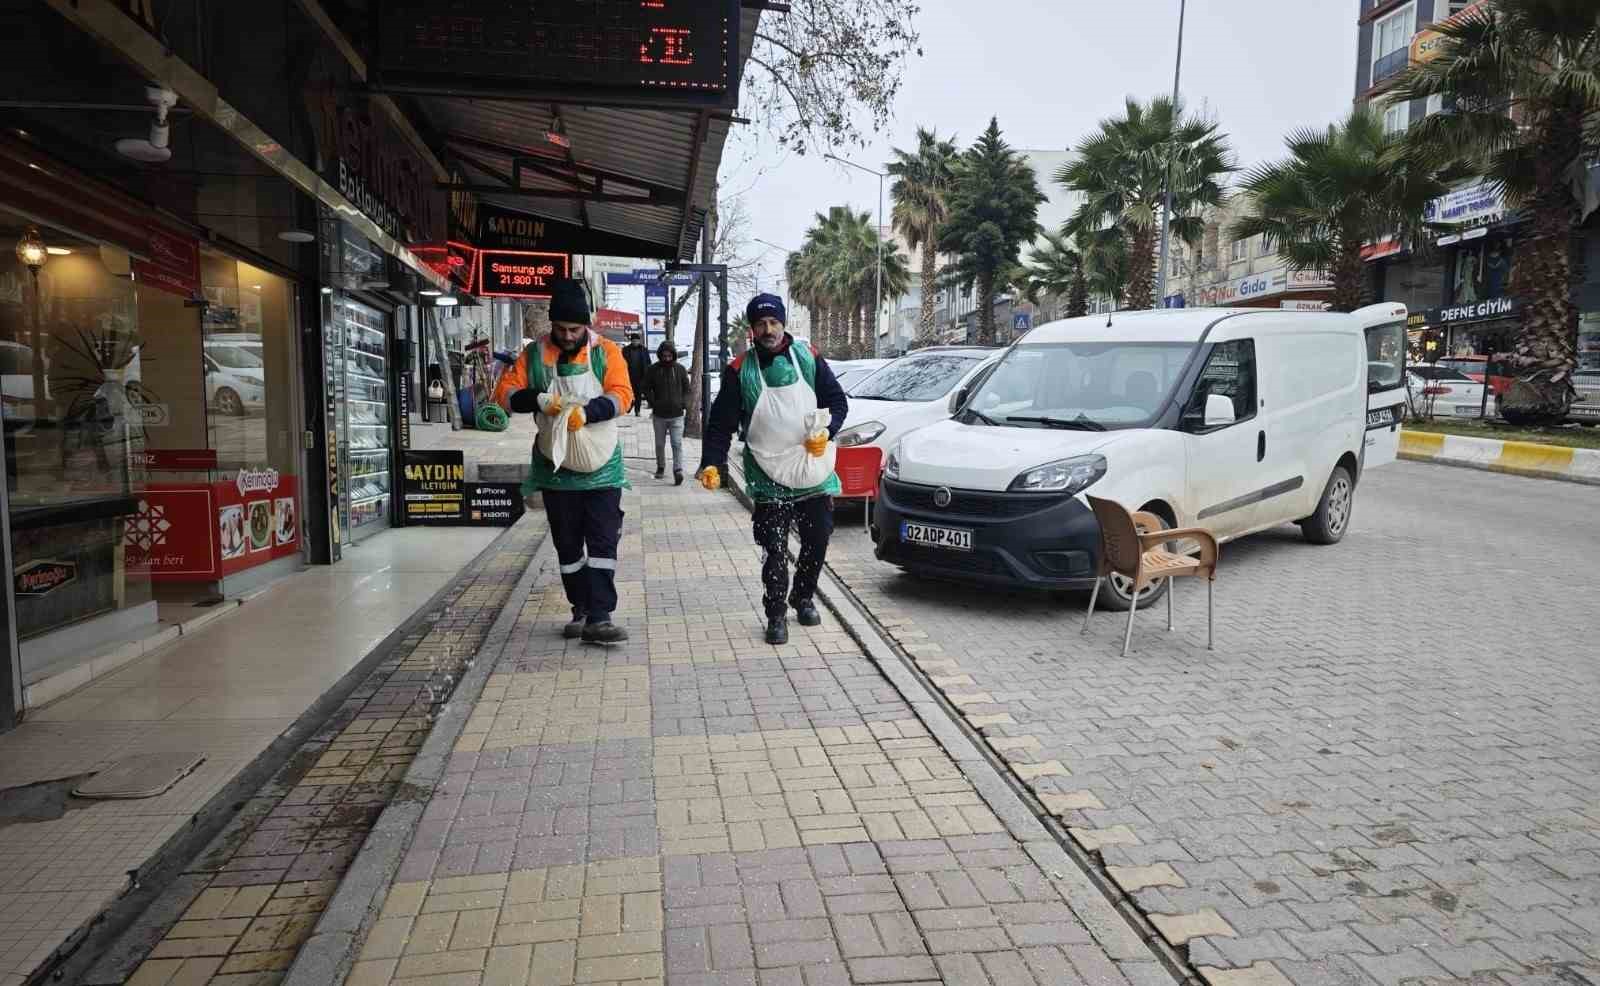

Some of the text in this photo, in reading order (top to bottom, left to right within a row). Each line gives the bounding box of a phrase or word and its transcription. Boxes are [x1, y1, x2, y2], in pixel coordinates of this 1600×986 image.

[496, 216, 545, 238] AYDIN
[491, 262, 535, 276] Samsung
[532, 275, 546, 286] TL
[1240, 279, 1267, 296] Gıda
[1440, 305, 1475, 321] DEFNE
[1476, 298, 1512, 316] GİYİM
[413, 464, 464, 480] AYDIN
[481, 487, 506, 495] iPhone
